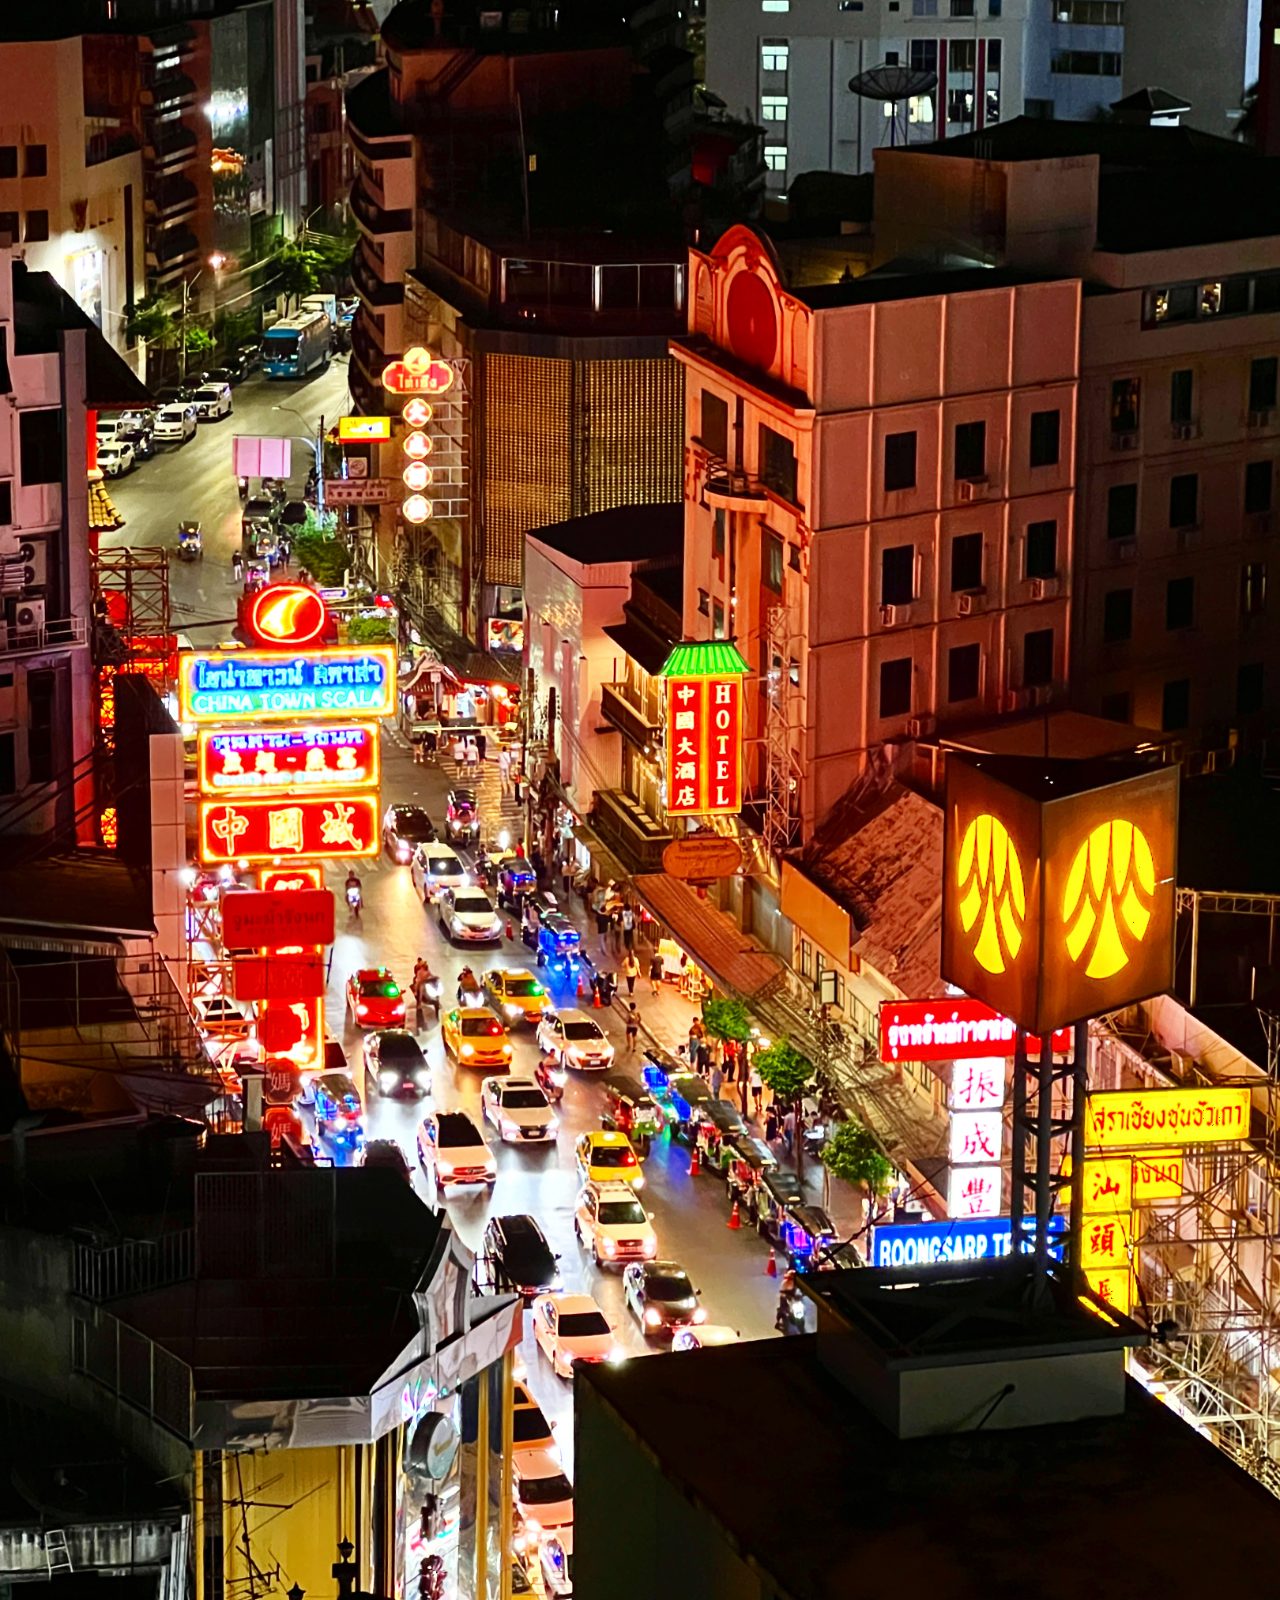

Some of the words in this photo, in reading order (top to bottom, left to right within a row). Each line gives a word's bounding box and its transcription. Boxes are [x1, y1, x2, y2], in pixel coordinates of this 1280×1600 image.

[193, 693, 253, 713] CHINA
[259, 691, 316, 713] TOWN
[321, 688, 384, 709] SCALA
[674, 685, 697, 807] 中國大酒店
[715, 684, 731, 806] HOTEL
[211, 802, 364, 857] 中國城
[959, 1067, 1000, 1216] 振成豐
[880, 1233, 988, 1267] ROONGSARP
